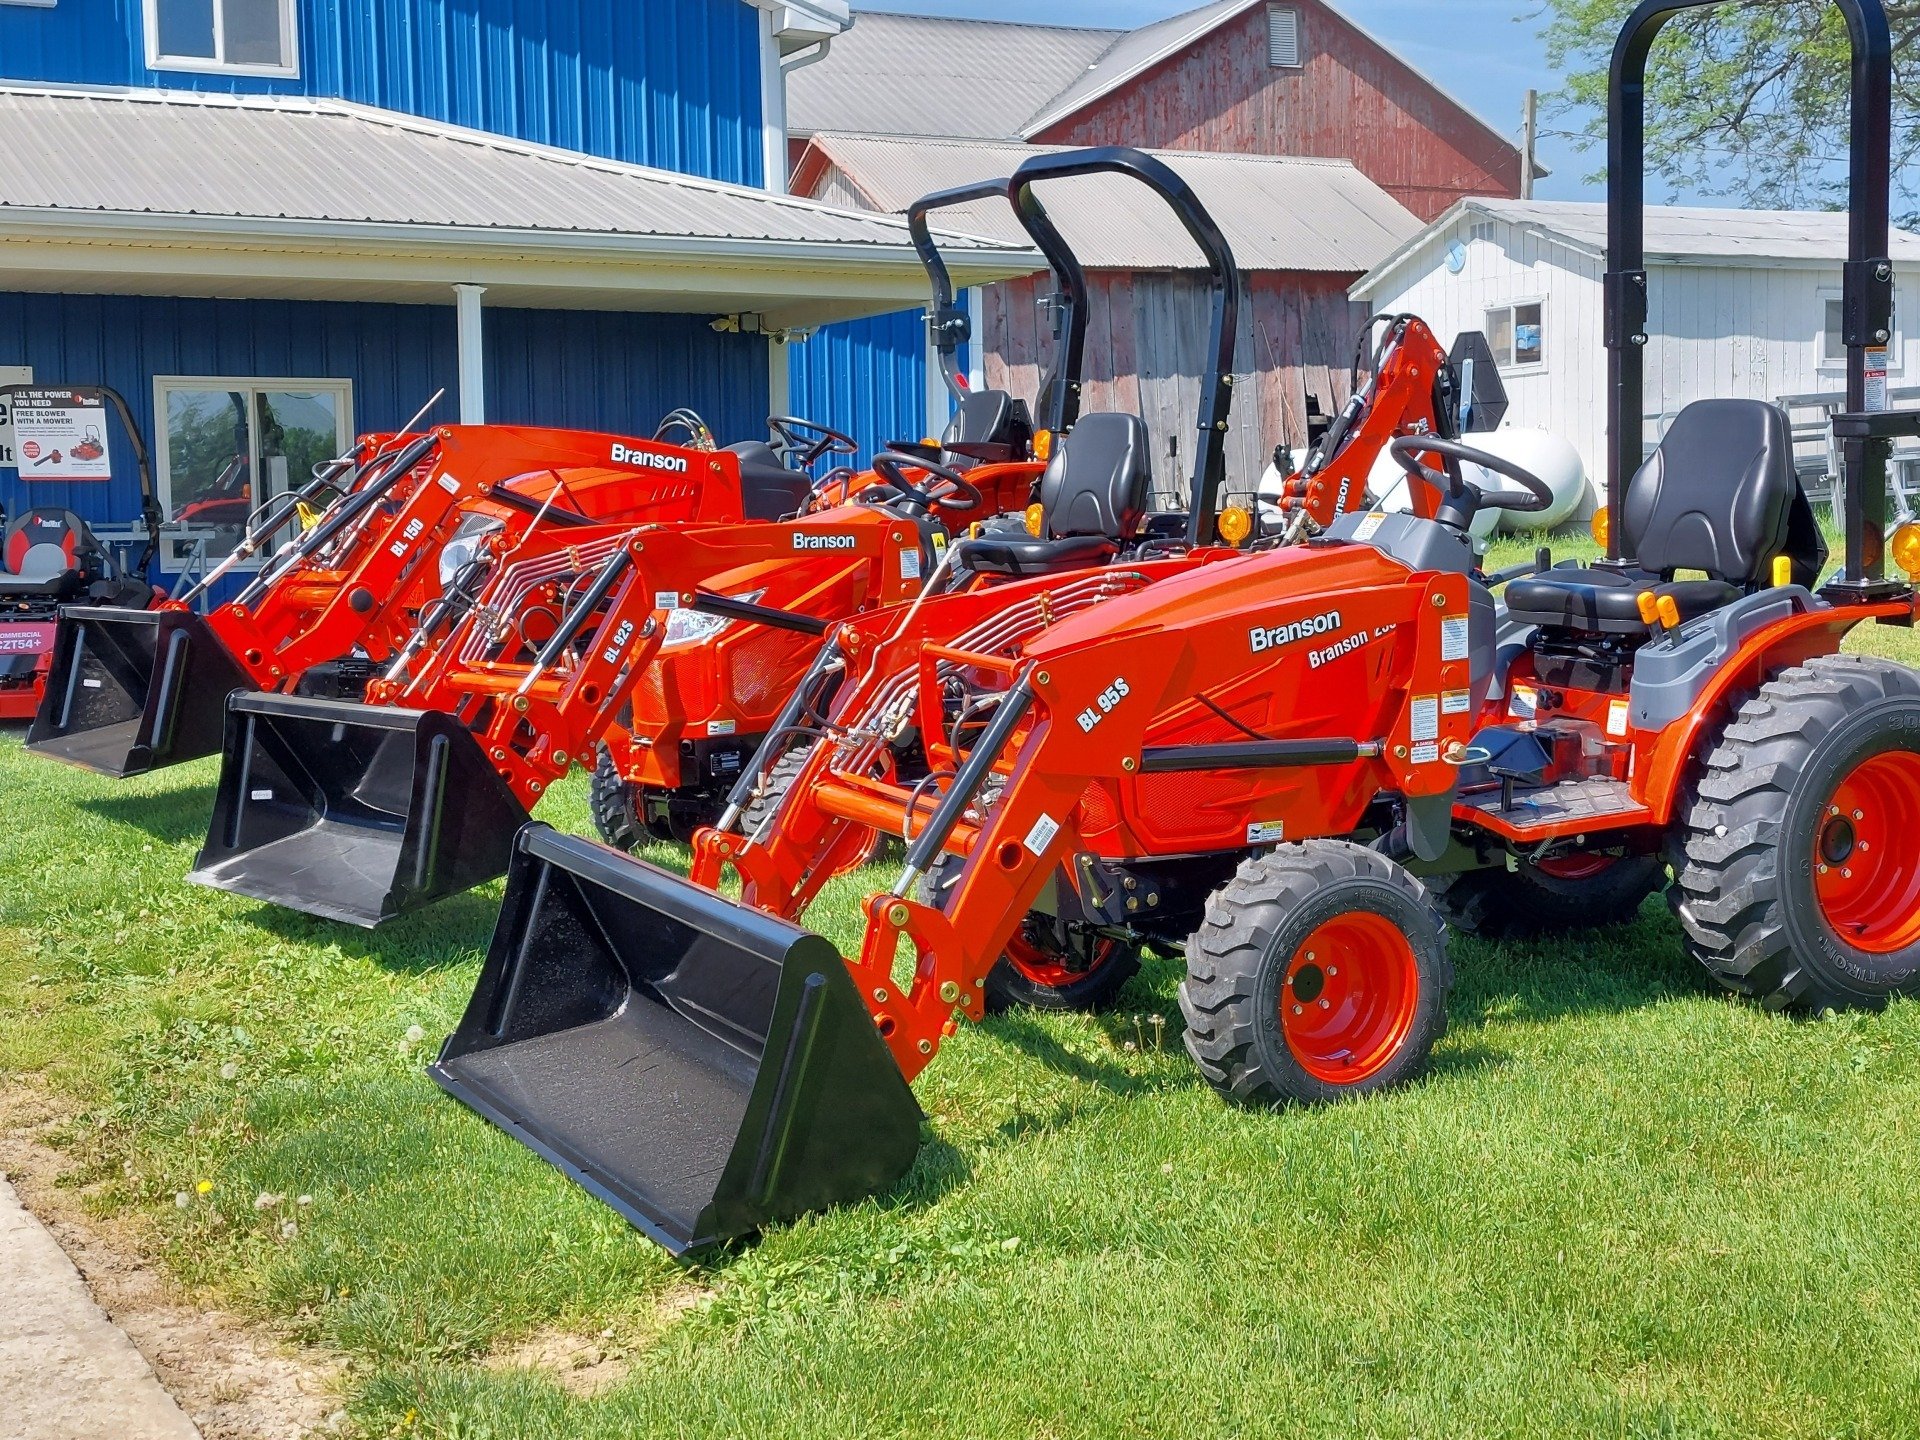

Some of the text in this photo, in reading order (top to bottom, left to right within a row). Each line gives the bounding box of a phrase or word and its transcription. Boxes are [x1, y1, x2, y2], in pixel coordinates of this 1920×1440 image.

[14, 391, 72, 399] ALL THE POWER
[611, 443, 687, 472] Branson
[1332, 477, 1350, 523] anson
[390, 518, 424, 558] BL 150
[793, 532, 855, 549] Branson
[0, 631, 42, 639] OMMERCIAL
[603, 620, 634, 664] BL 92S
[1249, 610, 1341, 652] Branson
[1308, 630, 1369, 669] Branson
[1076, 677, 1130, 733] BL 95S
